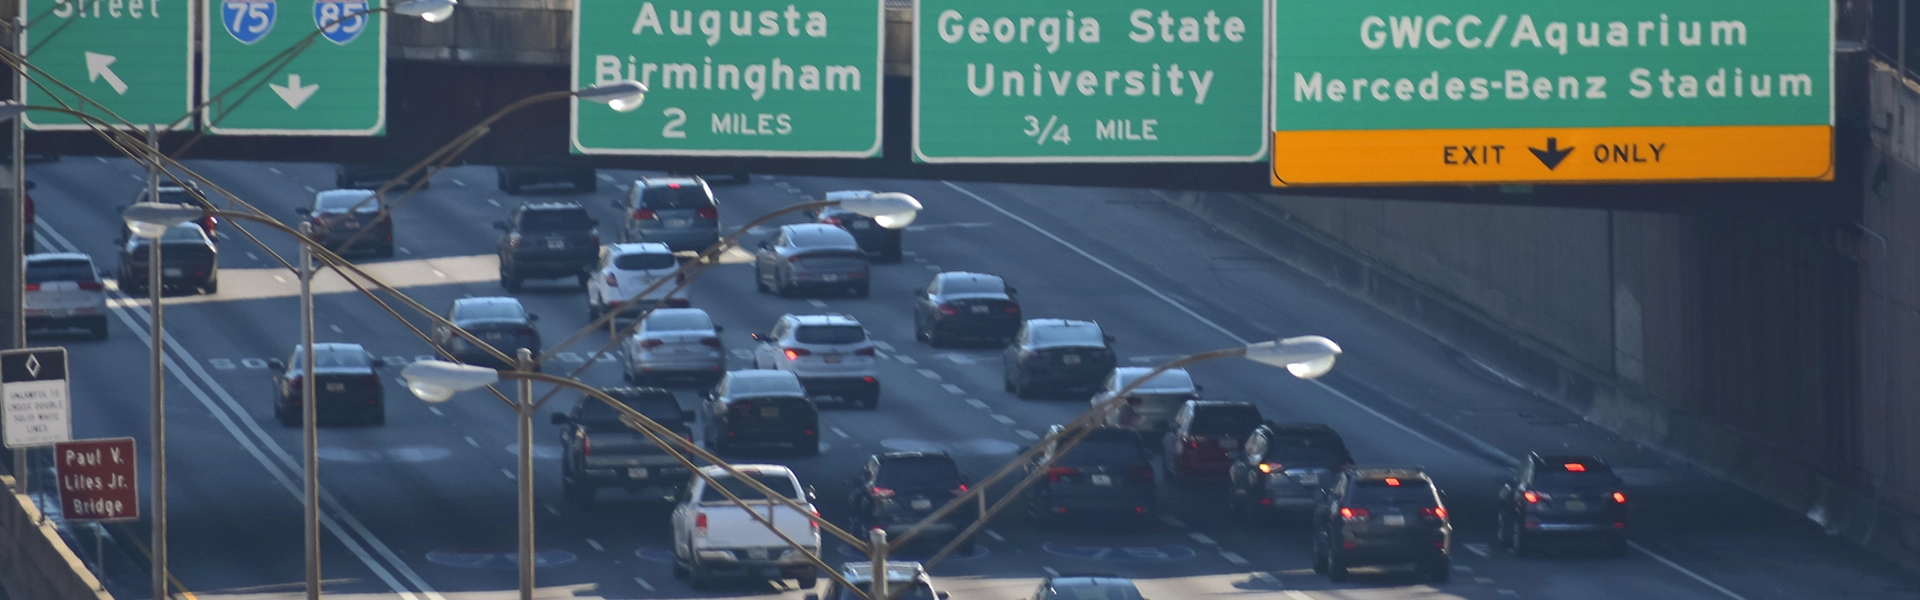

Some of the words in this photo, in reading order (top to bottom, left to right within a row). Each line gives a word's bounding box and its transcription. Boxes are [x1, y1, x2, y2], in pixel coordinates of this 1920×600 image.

[52, 0, 162, 19] Street
[226, 2, 271, 34] 75
[319, 2, 364, 34] 85
[631, 1, 828, 46] Augusta
[938, 9, 1101, 54] Georgia
[1128, 8, 1246, 43] State
[1360, 13, 1748, 54] GWCC/Aquarium
[595, 55, 862, 101] Birmingham
[967, 63, 1214, 105] University
[1294, 69, 1608, 102] Mercedes-Benz
[1628, 67, 1814, 98] Stadium
[662, 108, 687, 139] 2
[711, 113, 793, 135] MILES
[1023, 115, 1071, 145] 3/4
[1096, 119, 1158, 141] MILE
[1443, 144, 1505, 165] EXIT
[1594, 143, 1666, 164] ONLY
[66, 449, 101, 466] Paul
[110, 447, 124, 464] V.
[64, 475, 105, 491] Liles
[107, 473, 128, 490] Jr.
[73, 499, 123, 517] Bridge
